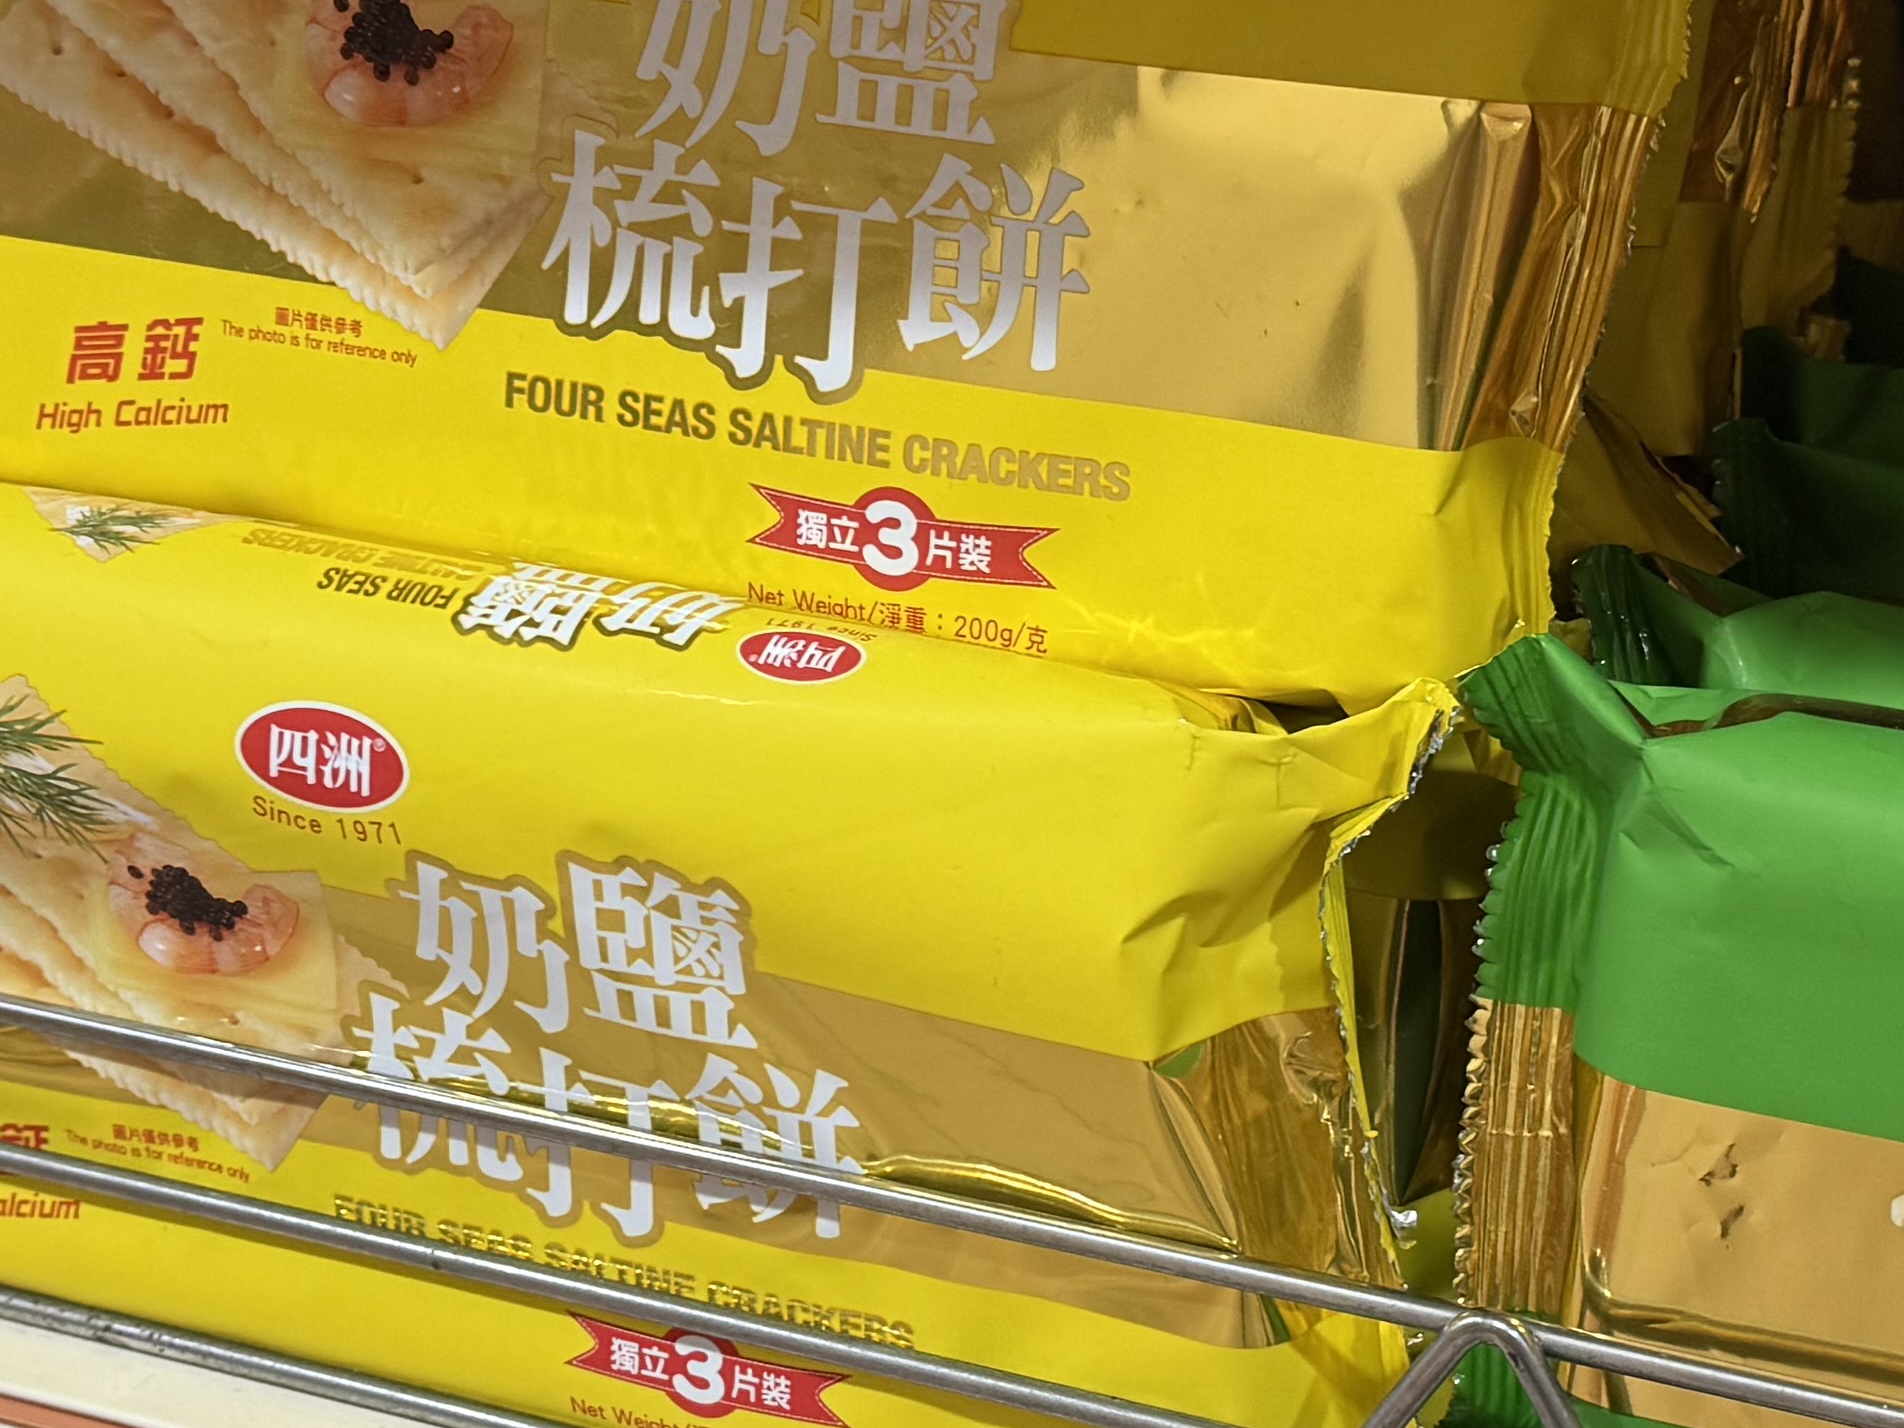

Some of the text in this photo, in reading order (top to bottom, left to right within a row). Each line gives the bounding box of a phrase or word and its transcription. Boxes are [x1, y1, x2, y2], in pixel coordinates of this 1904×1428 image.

[540, 127, 1092, 394] 梳打餅
[65, 316, 206, 386] 高鈣
[219, 319, 418, 369] The photo is for reference only
[36, 397, 230, 435] High Calcium
[504, 370, 1133, 503] FOUR SEAS SALTINE CRACKERS
[795, 499, 994, 577] 獨立3片裝
[316, 565, 461, 612] FOUR SEAS
[747, 581, 786, 609] Net
[761, 633, 843, 675] 四洲
[266, 723, 374, 800] 四洲
[251, 795, 406, 846] Since 1971
[398, 859, 759, 1051] 奶鹽
[353, 995, 866, 1240] 梳打餅
[167, 1149, 252, 1185] reference only
[609, 1334, 792, 1411] 獨立3片裝
[569, 1395, 607, 1421] Net
